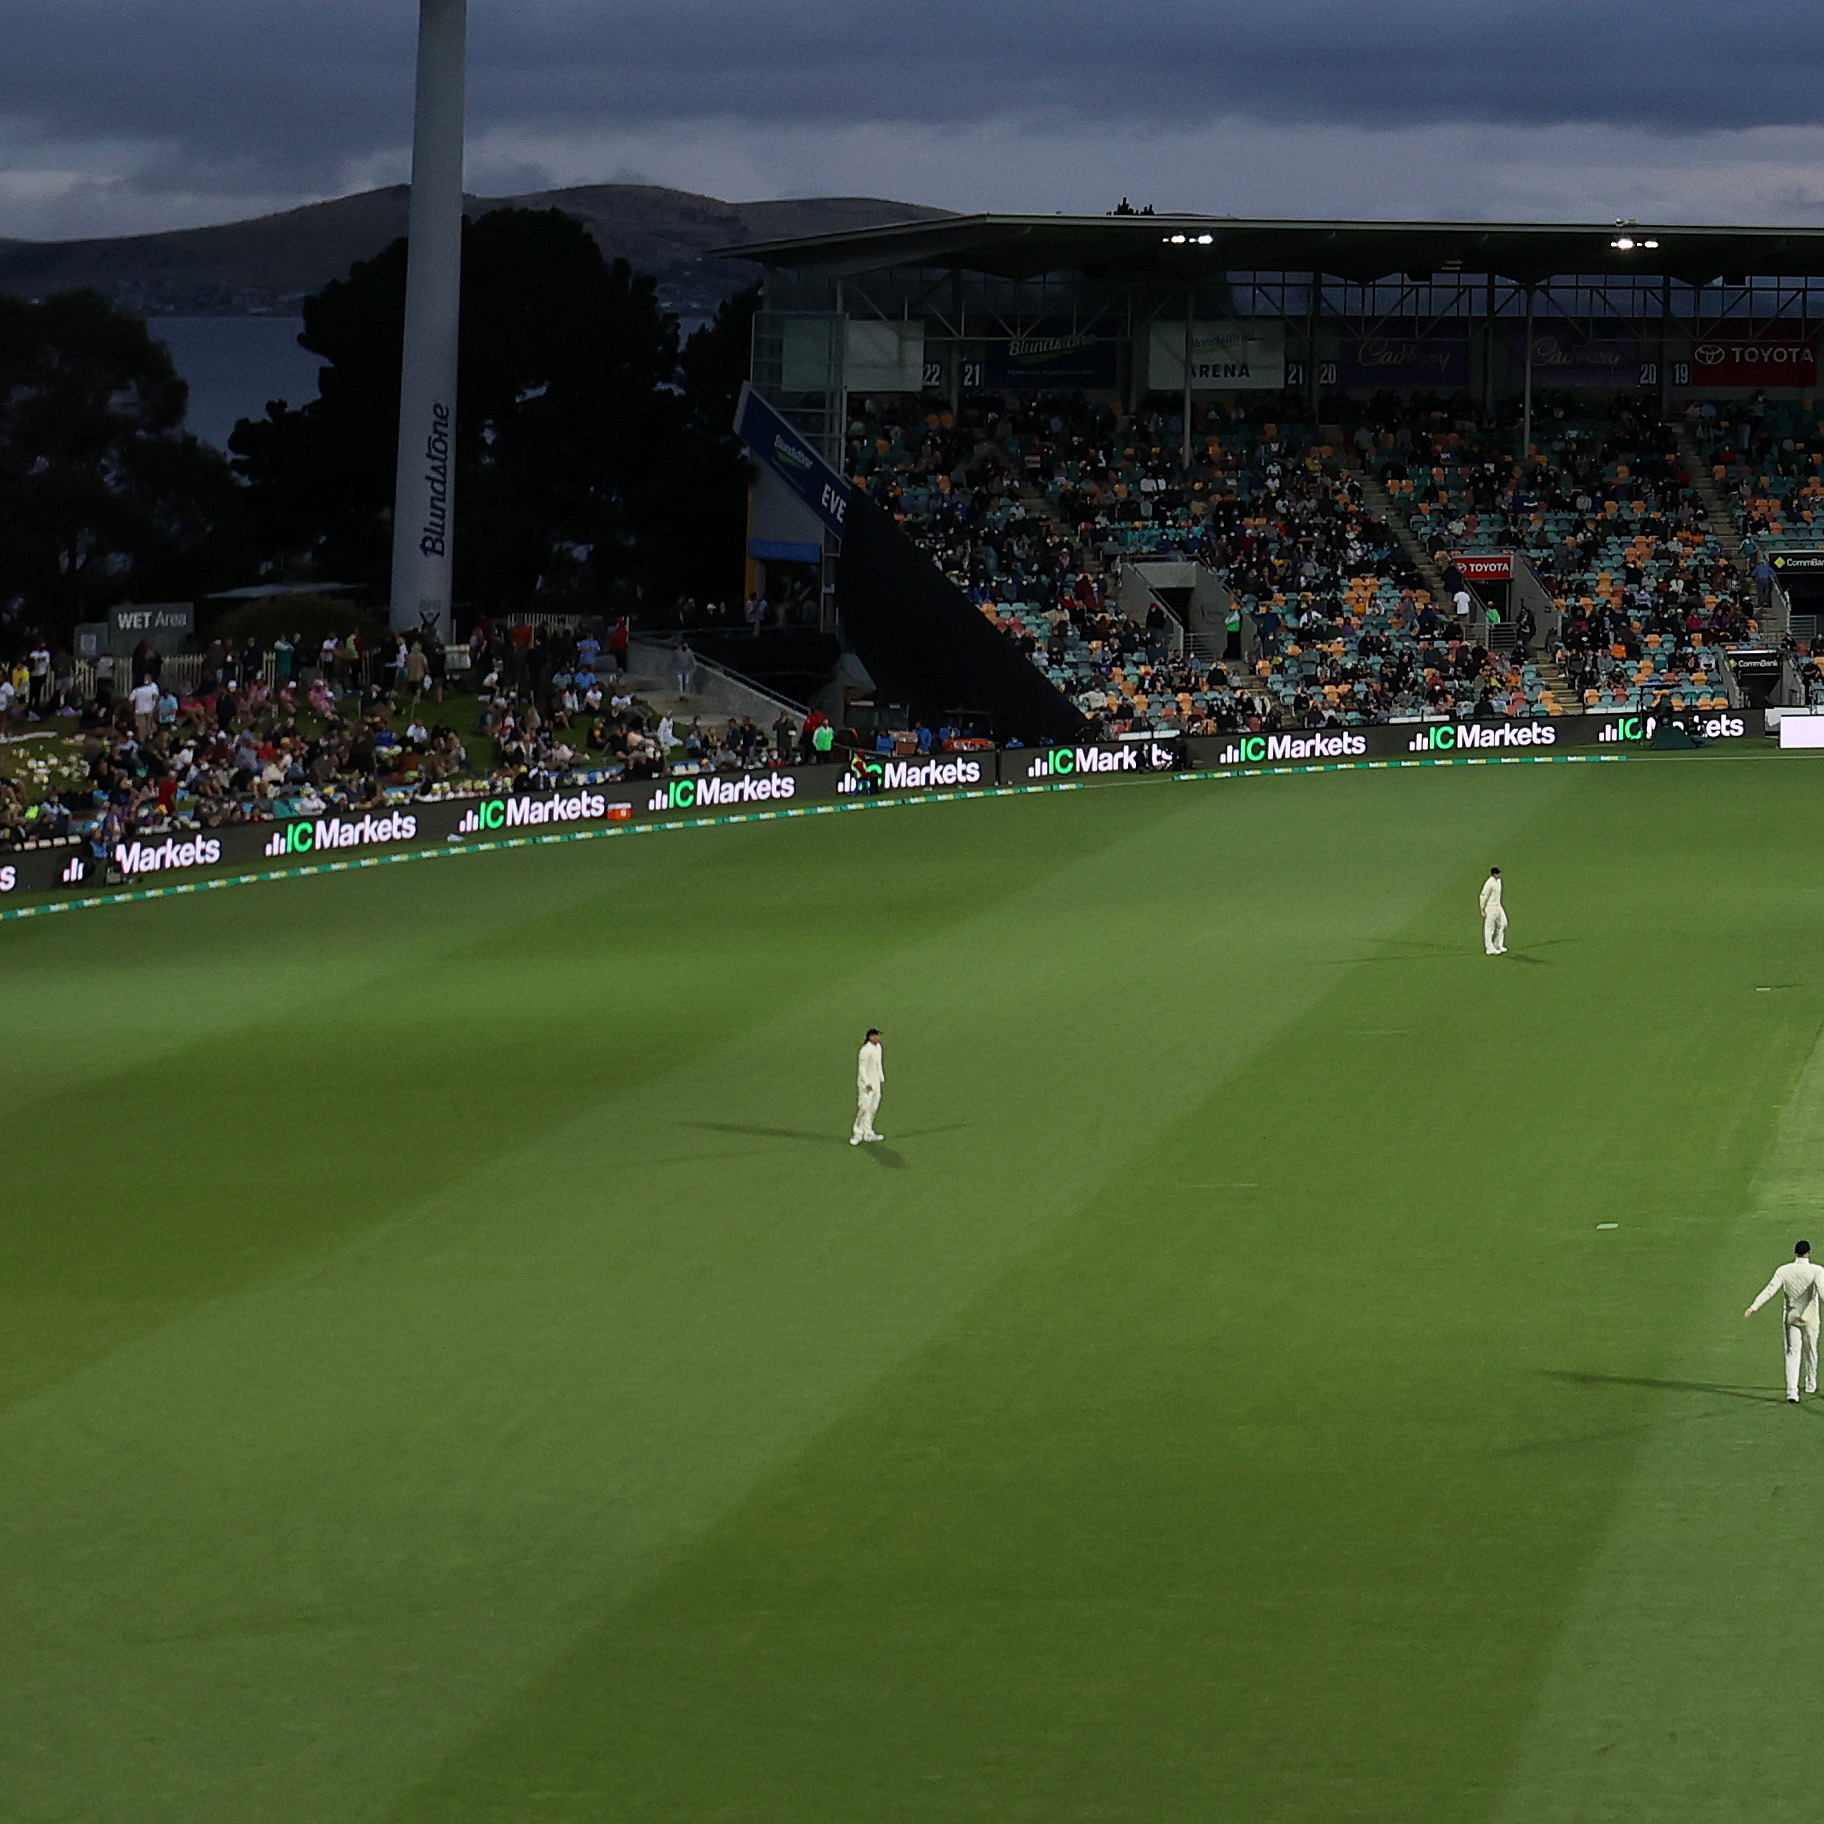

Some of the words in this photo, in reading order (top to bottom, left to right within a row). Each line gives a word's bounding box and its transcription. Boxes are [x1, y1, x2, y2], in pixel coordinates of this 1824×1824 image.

[1357, 340, 1450, 374] Cady
[1731, 347, 1814, 363] TOYOTA
[923, 364, 940, 386] 22
[964, 363, 980, 386] 21
[1287, 363, 1303, 385] 21
[1319, 363, 1336, 385] 20
[1640, 364, 1656, 385] 20
[1675, 364, 1689, 385] 19
[419, 403, 449, 557] Blundstone
[1469, 562, 1510, 573] TOYOTA
[118, 611, 152, 630] WET
[155, 611, 187, 627] Area
[1738, 658, 1779, 667] CommBank
[1268, 731, 1366, 760] Markets
[1457, 722, 1556, 749] Markets
[885, 758, 980, 788] Markets
[697, 774, 795, 806] Markets
[507, 792, 605, 827] Markets
[315, 811, 416, 850] Markets
[116, 834, 220, 874] Markets
